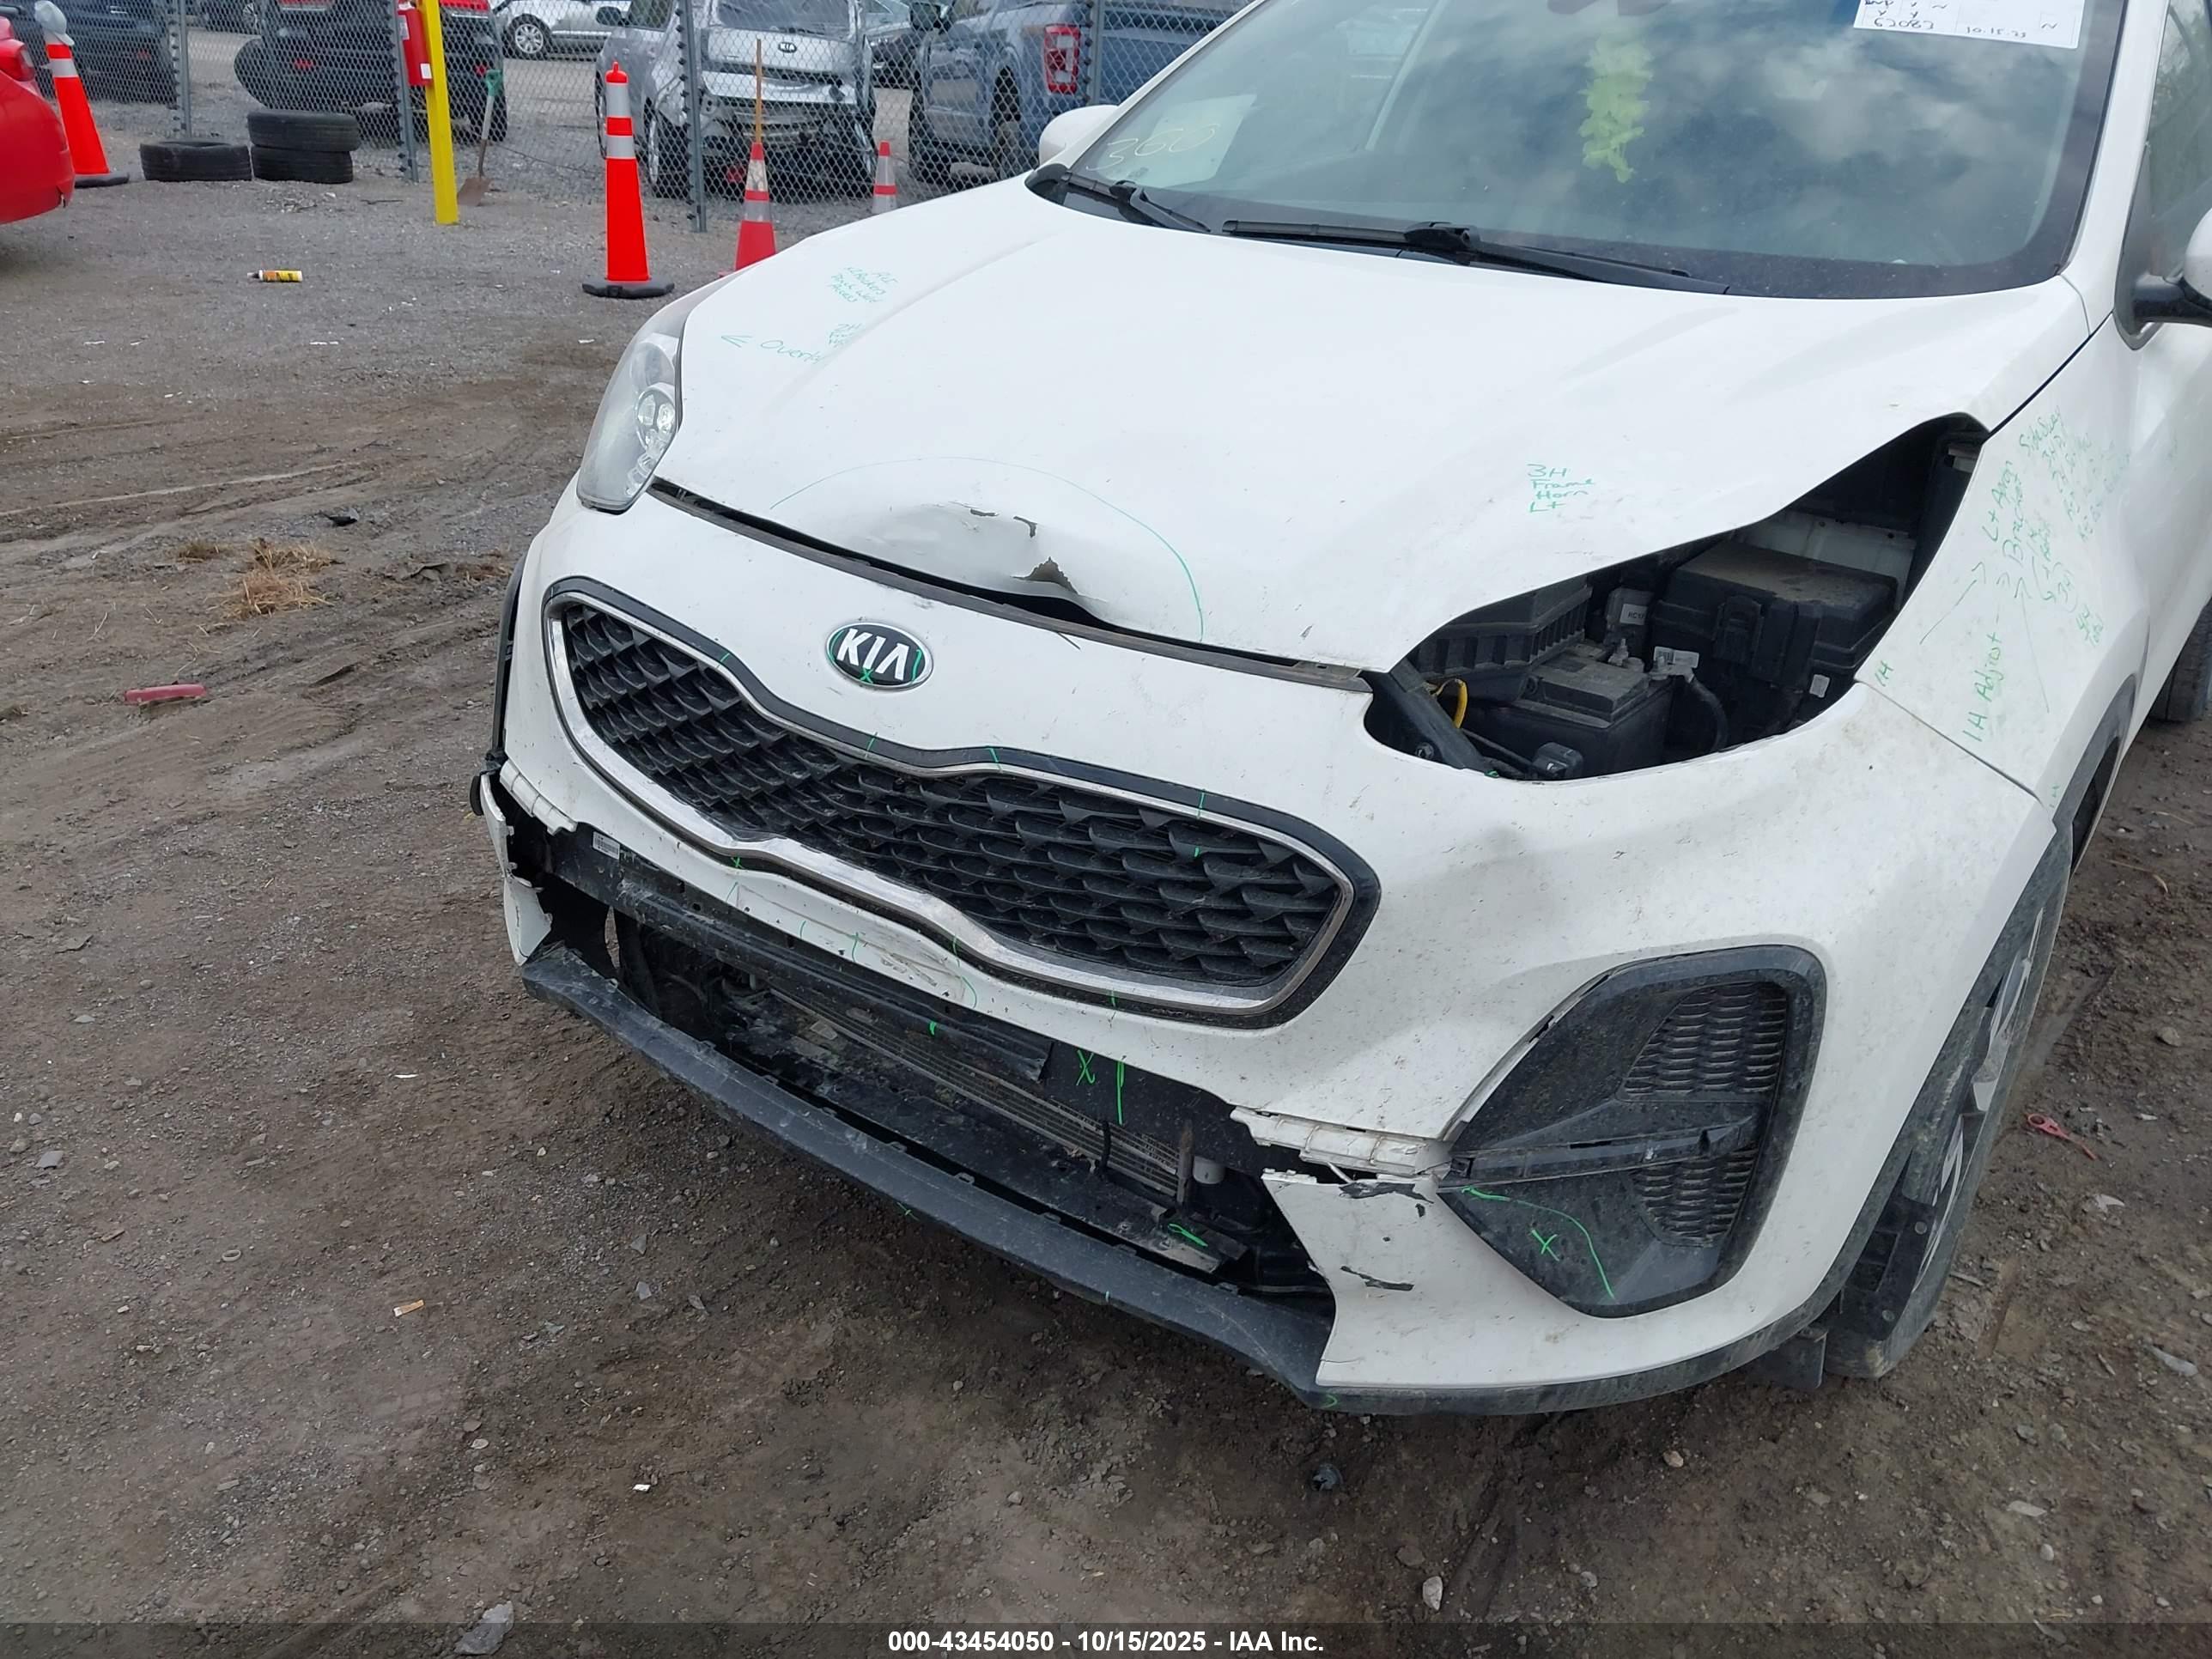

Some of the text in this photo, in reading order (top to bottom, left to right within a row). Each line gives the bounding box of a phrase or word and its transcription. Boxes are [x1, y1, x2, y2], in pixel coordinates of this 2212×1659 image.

[1085, 124, 1220, 172] 360
[1527, 464, 1568, 477] 3H
[1531, 477, 1595, 489] Frame
[1535, 490, 1589, 500] Horn
[836, 628, 909, 681] KIA
